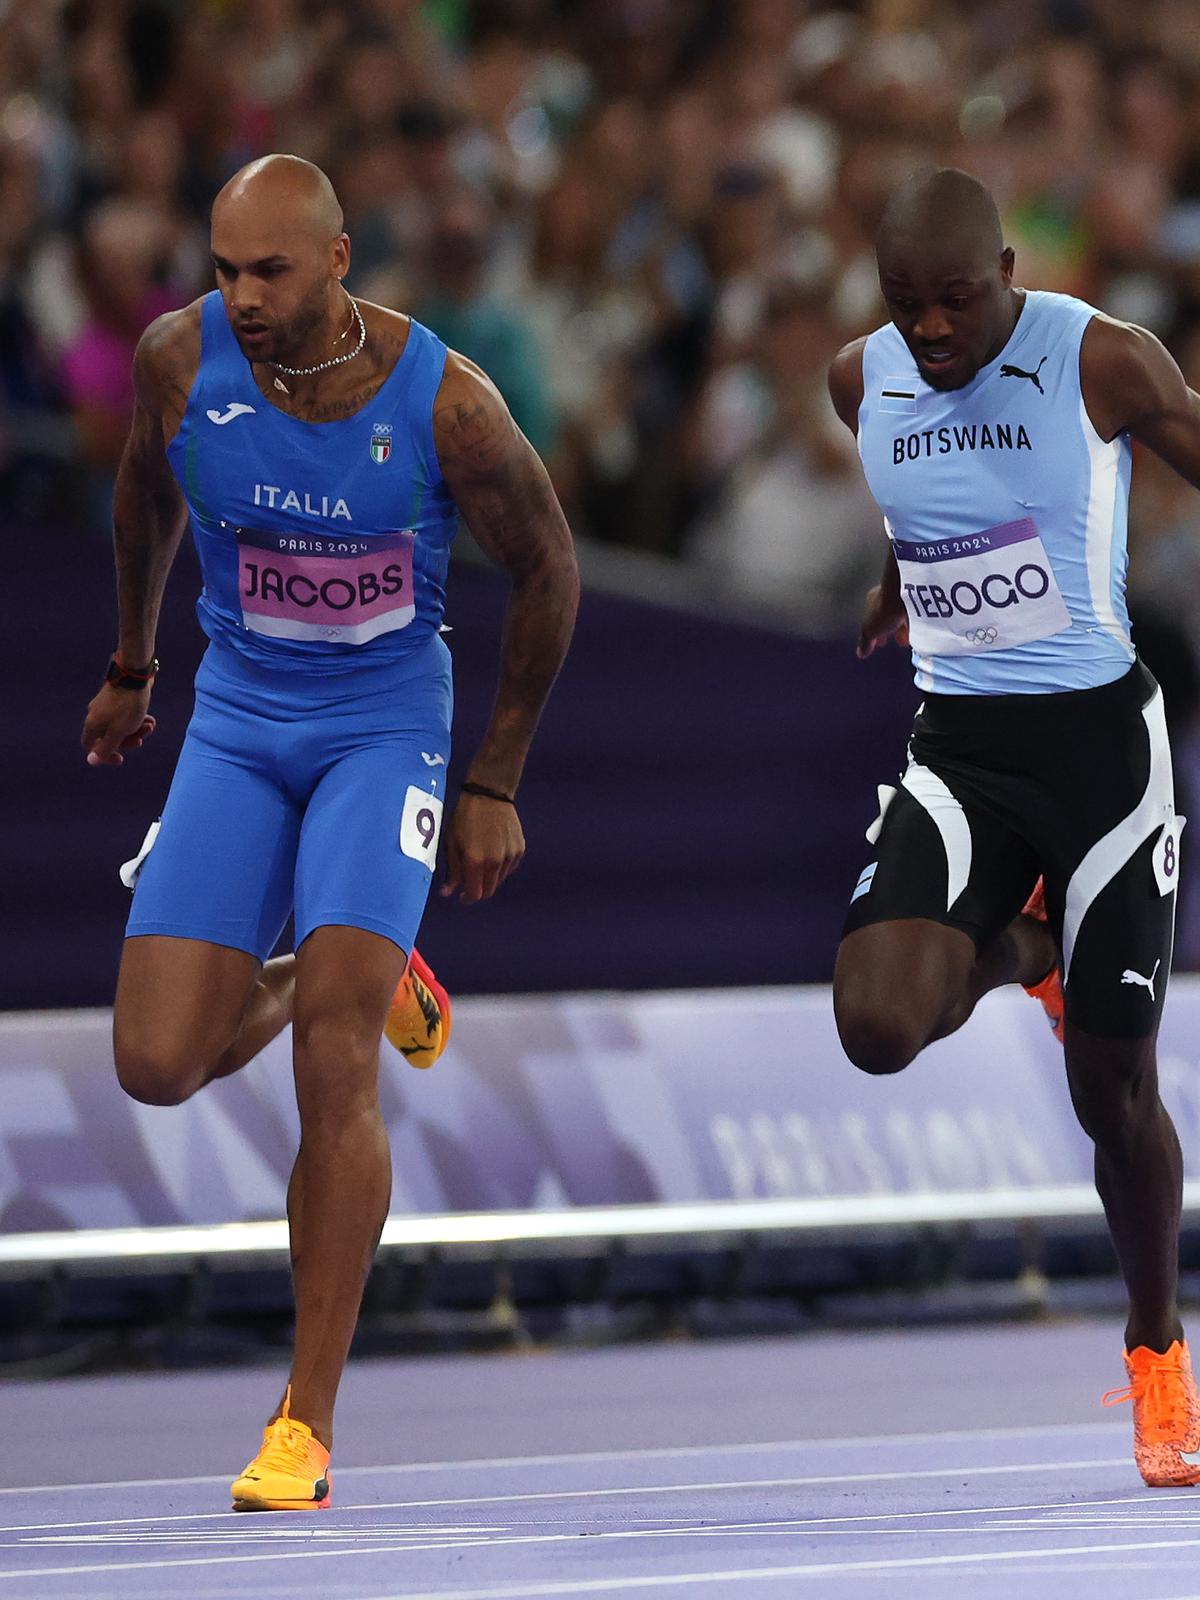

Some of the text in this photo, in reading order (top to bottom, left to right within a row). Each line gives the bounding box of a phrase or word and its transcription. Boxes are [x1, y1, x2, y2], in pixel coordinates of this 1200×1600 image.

[892, 424, 1032, 465] BOTSWANA
[253, 484, 352, 520] ITALIA
[279, 539, 368, 553] PARIS 2024
[915, 536, 991, 557] PARIS 2024
[245, 564, 403, 610] JACOBS
[904, 564, 1049, 618] TEBOGO
[416, 808, 436, 850] 9
[1163, 834, 1175, 877] 8
